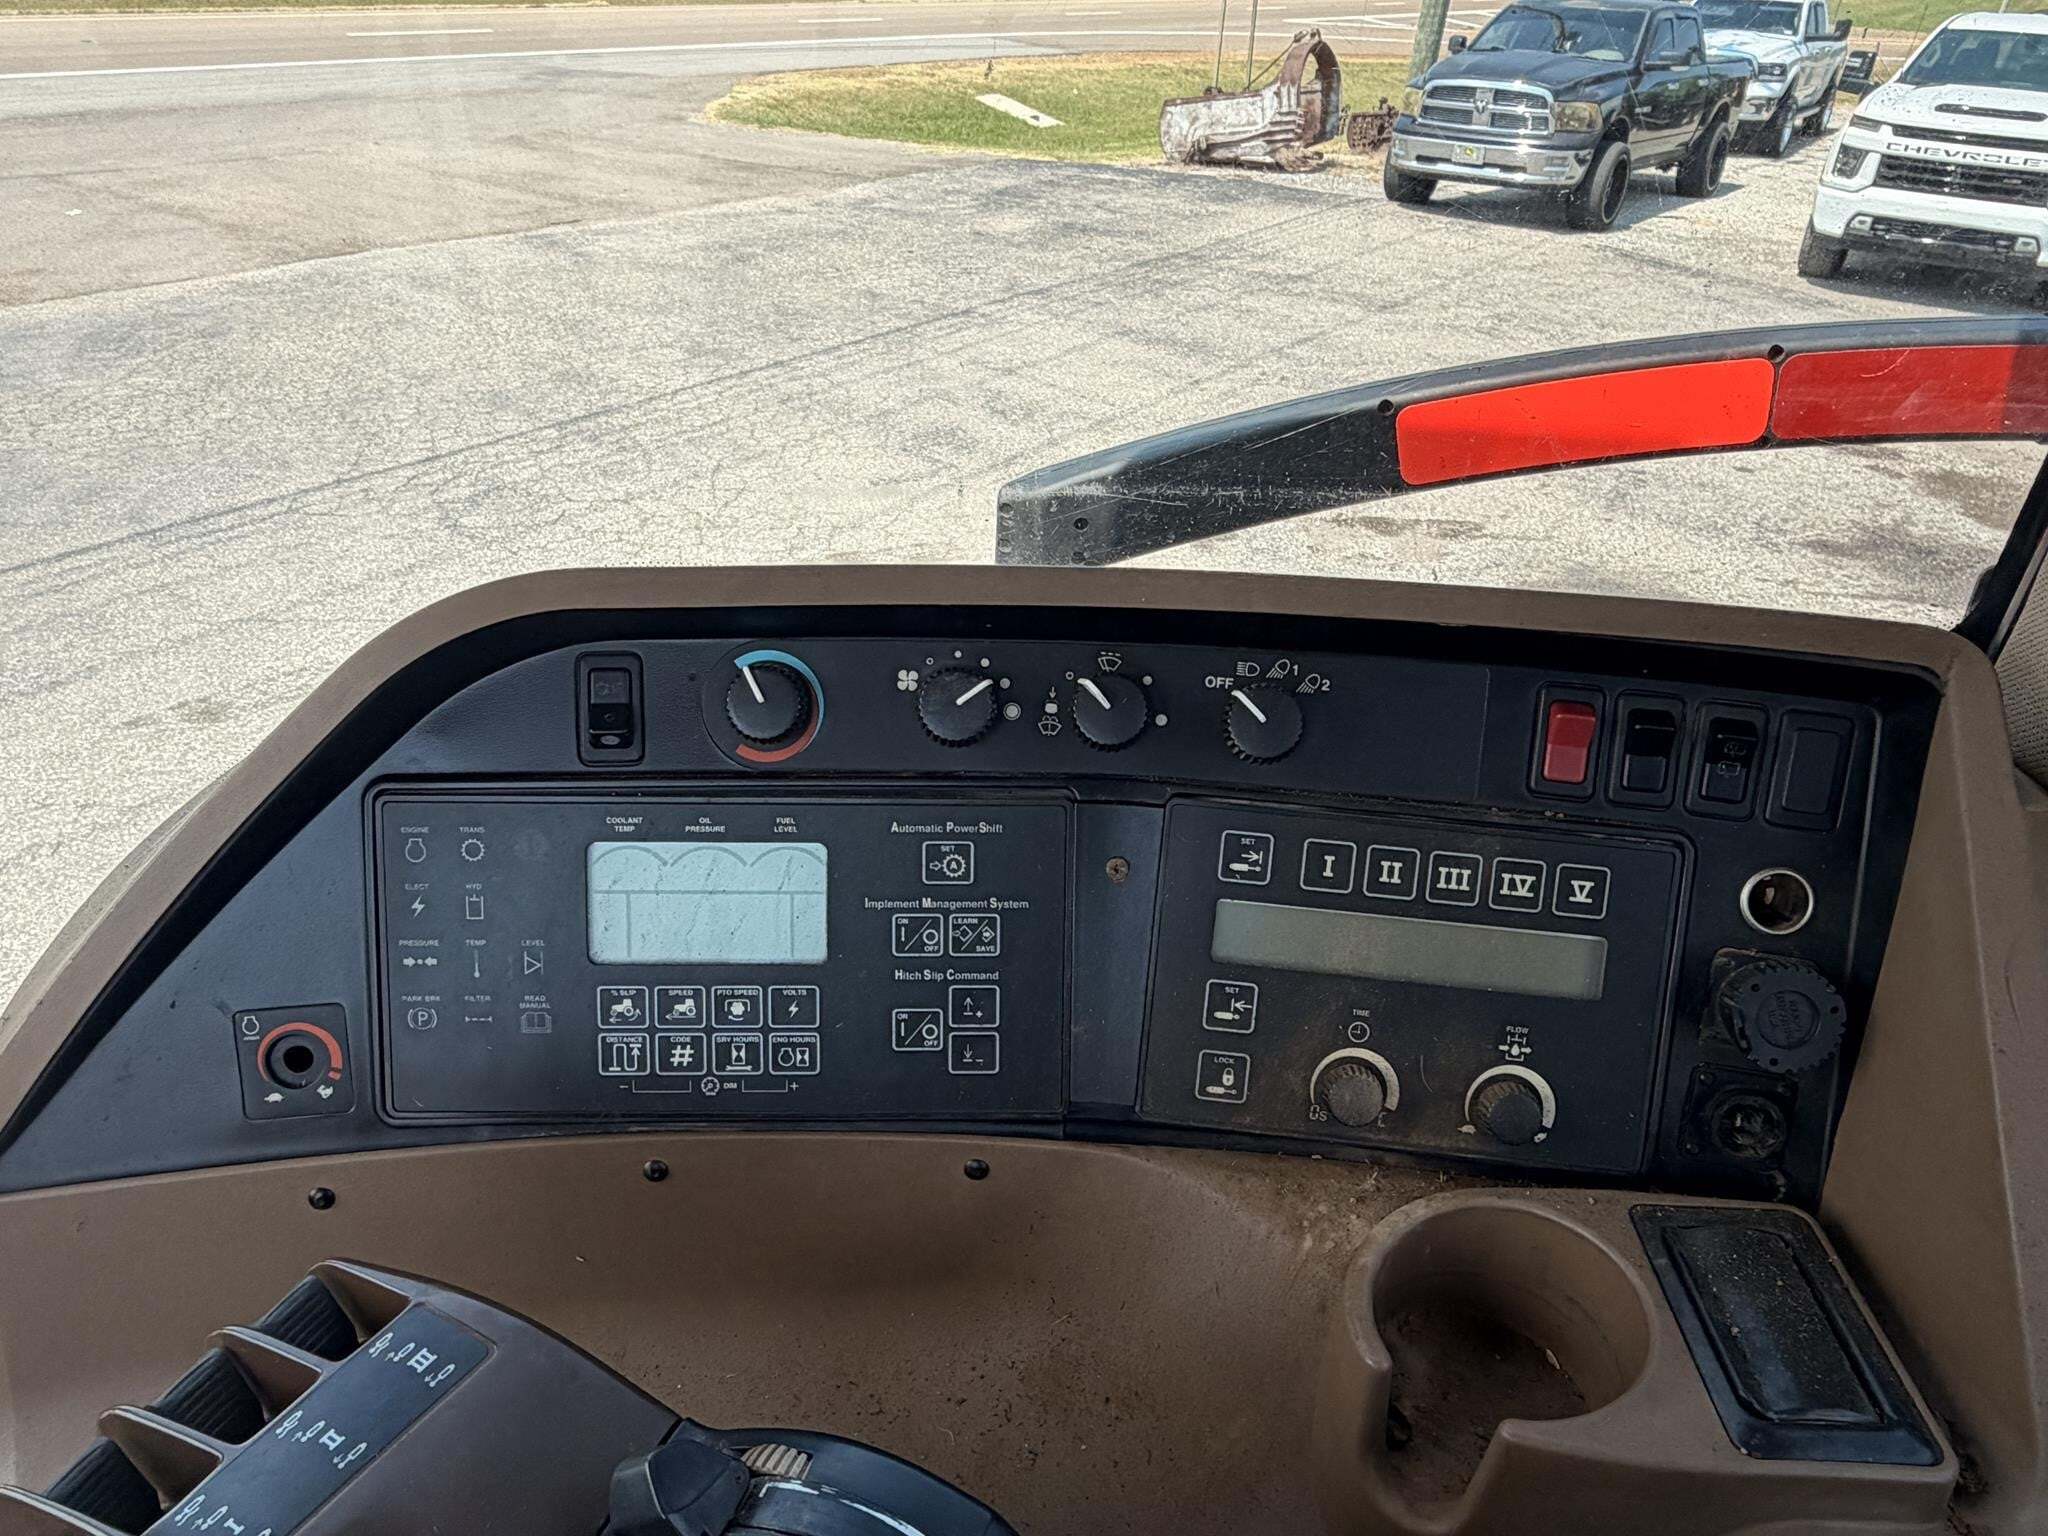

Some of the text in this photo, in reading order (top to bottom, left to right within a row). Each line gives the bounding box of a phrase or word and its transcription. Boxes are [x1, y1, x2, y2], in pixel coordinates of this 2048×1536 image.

[1886, 142, 2048, 168] CHEVROLE
[1292, 664, 1299, 676] 1
[1204, 675, 1234, 689] OFF
[1321, 679, 1331, 691] 2
[891, 822, 1003, 834] Automatic PowerShift
[1322, 855, 1336, 877] I
[1379, 860, 1403, 884] II
[1436, 866, 1472, 891] III
[1499, 873, 1537, 898] IV
[1568, 879, 1595, 904] V
[864, 897, 1029, 910] Implement Management System
[399, 939, 440, 947] PRESSURE
[894, 969, 1000, 982] Hitch Slip Command
[1224, 986, 1240, 994] SET
[1352, 1009, 1370, 1018] TIME
[1505, 1025, 1530, 1034] FLOW
[1214, 1056, 1235, 1064] LOCK
[407, 1348, 438, 1374] III
[318, 1429, 346, 1451] II
